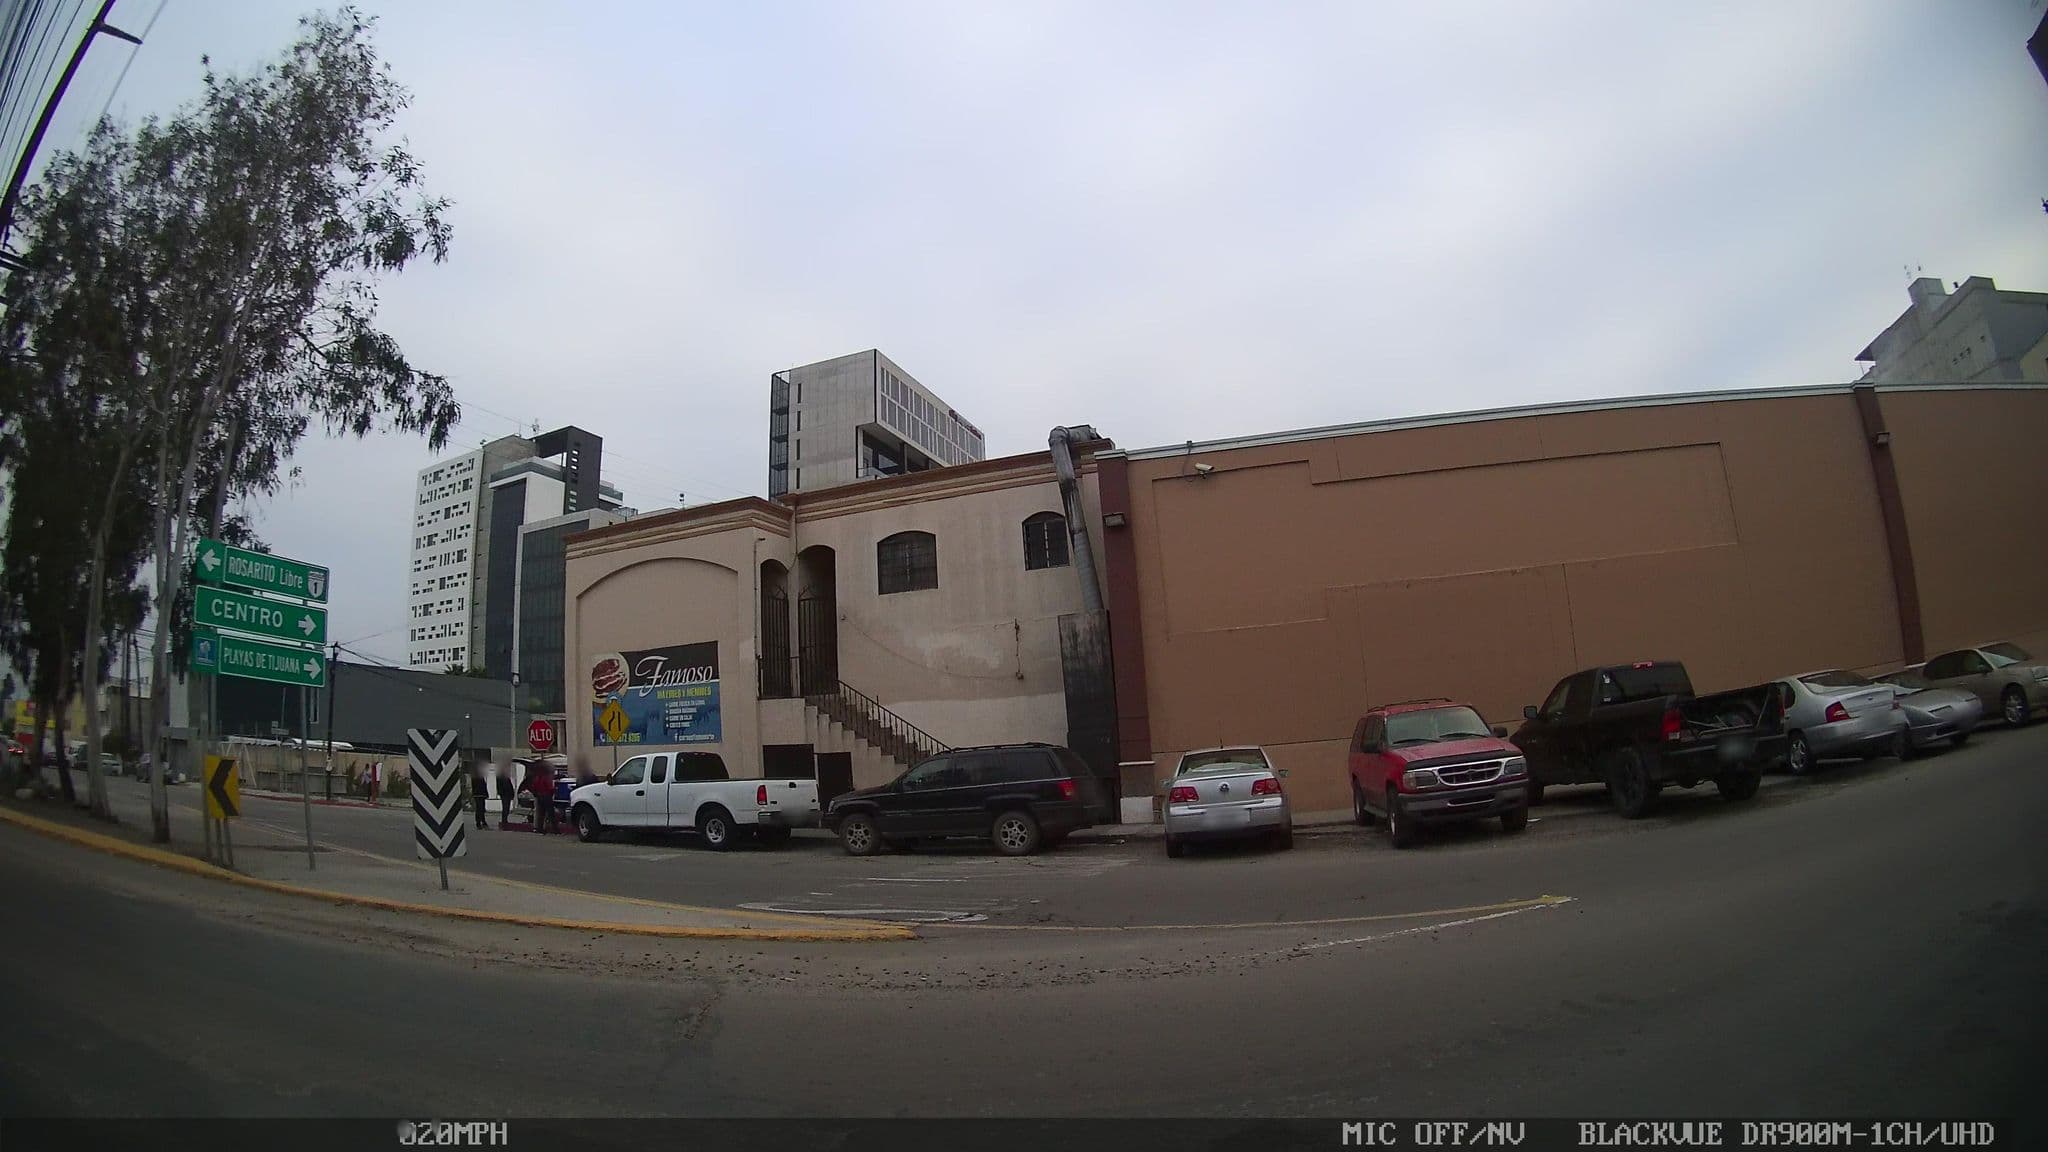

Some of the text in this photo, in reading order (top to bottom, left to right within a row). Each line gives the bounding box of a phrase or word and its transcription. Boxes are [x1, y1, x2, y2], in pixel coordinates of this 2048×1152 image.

[228, 556, 275, 582] ROSARITO
[279, 568, 303, 588] Libre
[211, 598, 283, 628] CENTRO
[224, 647, 300, 674] PLAYAS DE TIJUANA
[635, 655, 713, 697] Famoso
[530, 728, 552, 741] ALTO
